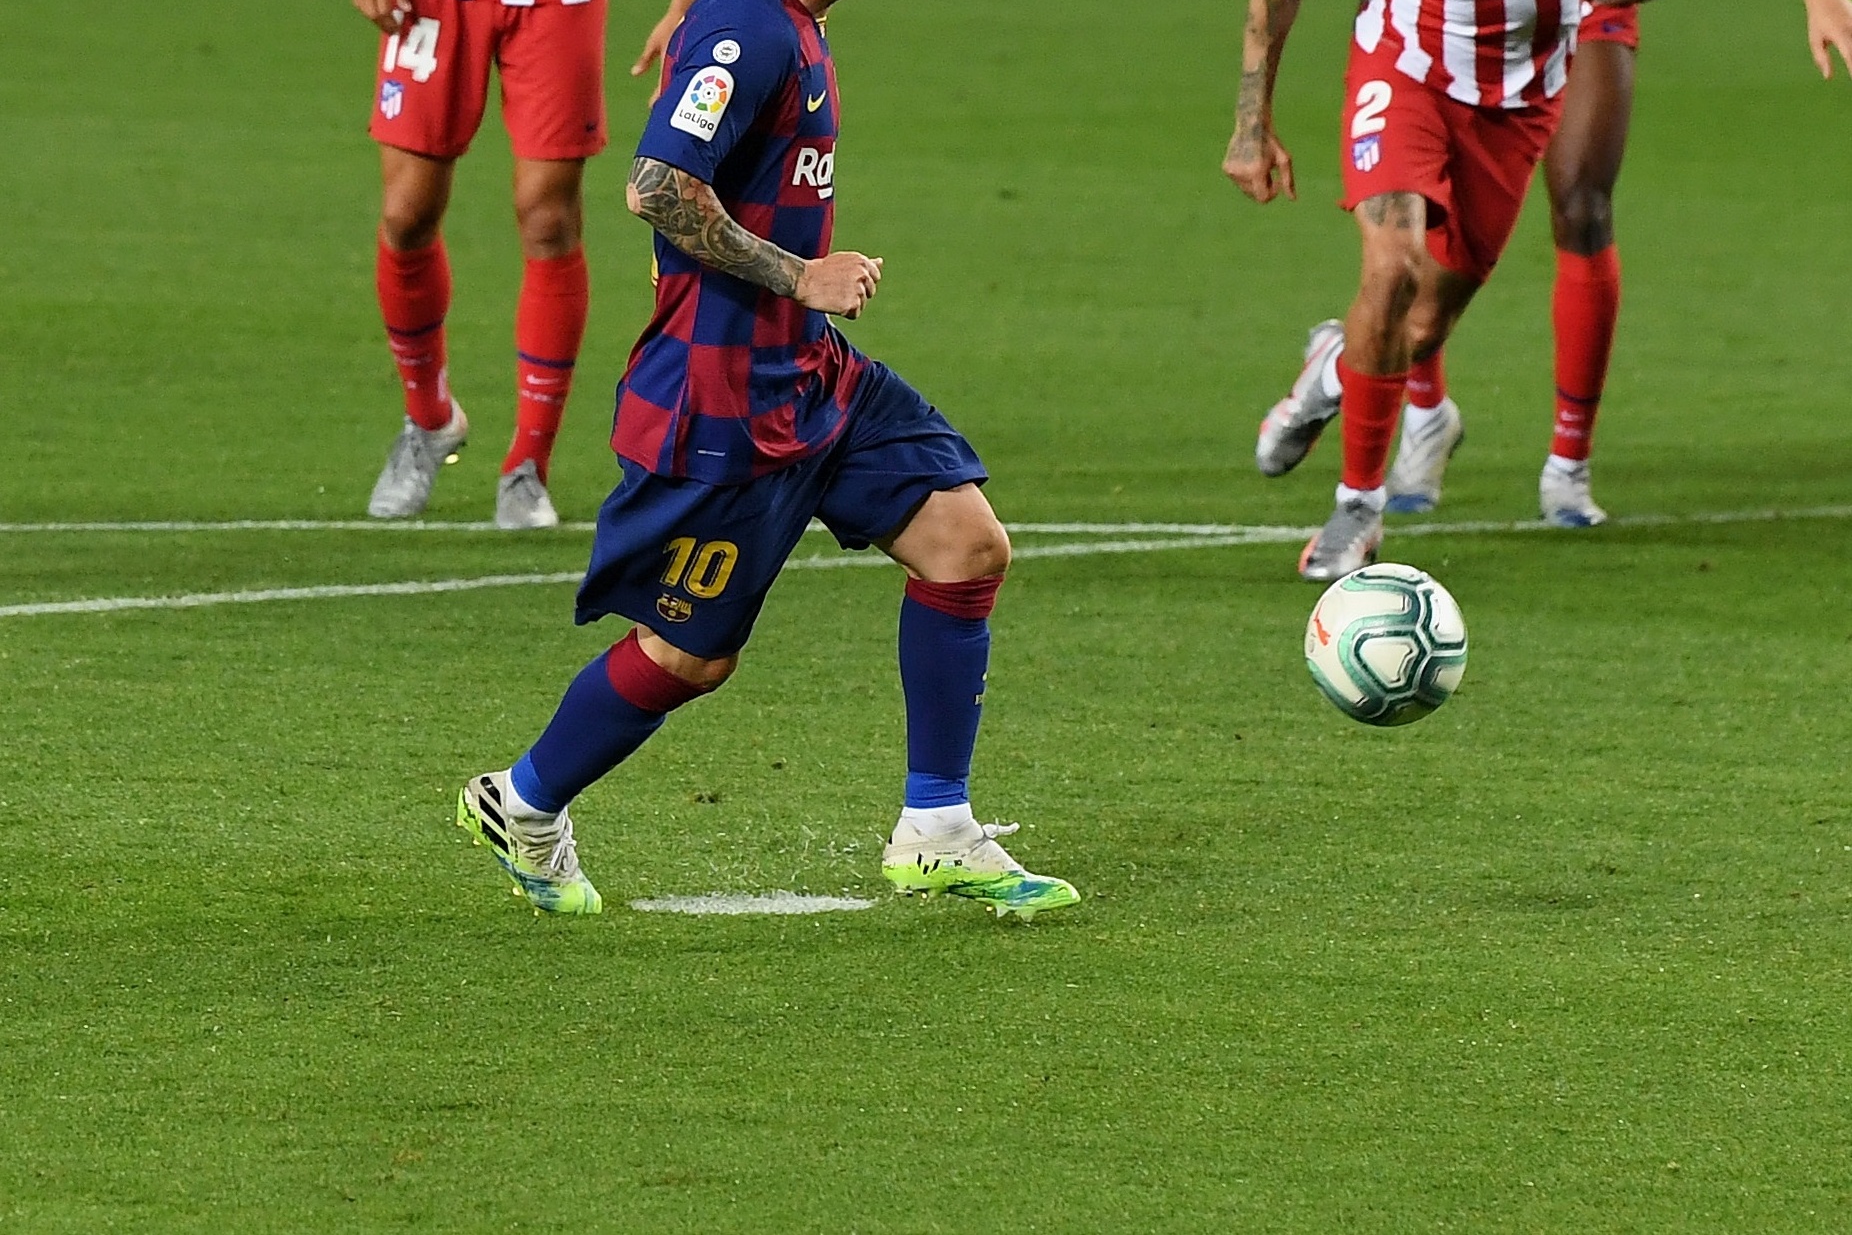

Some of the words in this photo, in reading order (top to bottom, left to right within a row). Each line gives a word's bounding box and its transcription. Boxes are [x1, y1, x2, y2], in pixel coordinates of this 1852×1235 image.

[383, 9, 441, 83] 14
[679, 109, 715, 132] LaLiga
[1351, 79, 1393, 140] 2
[660, 537, 739, 599] 10
